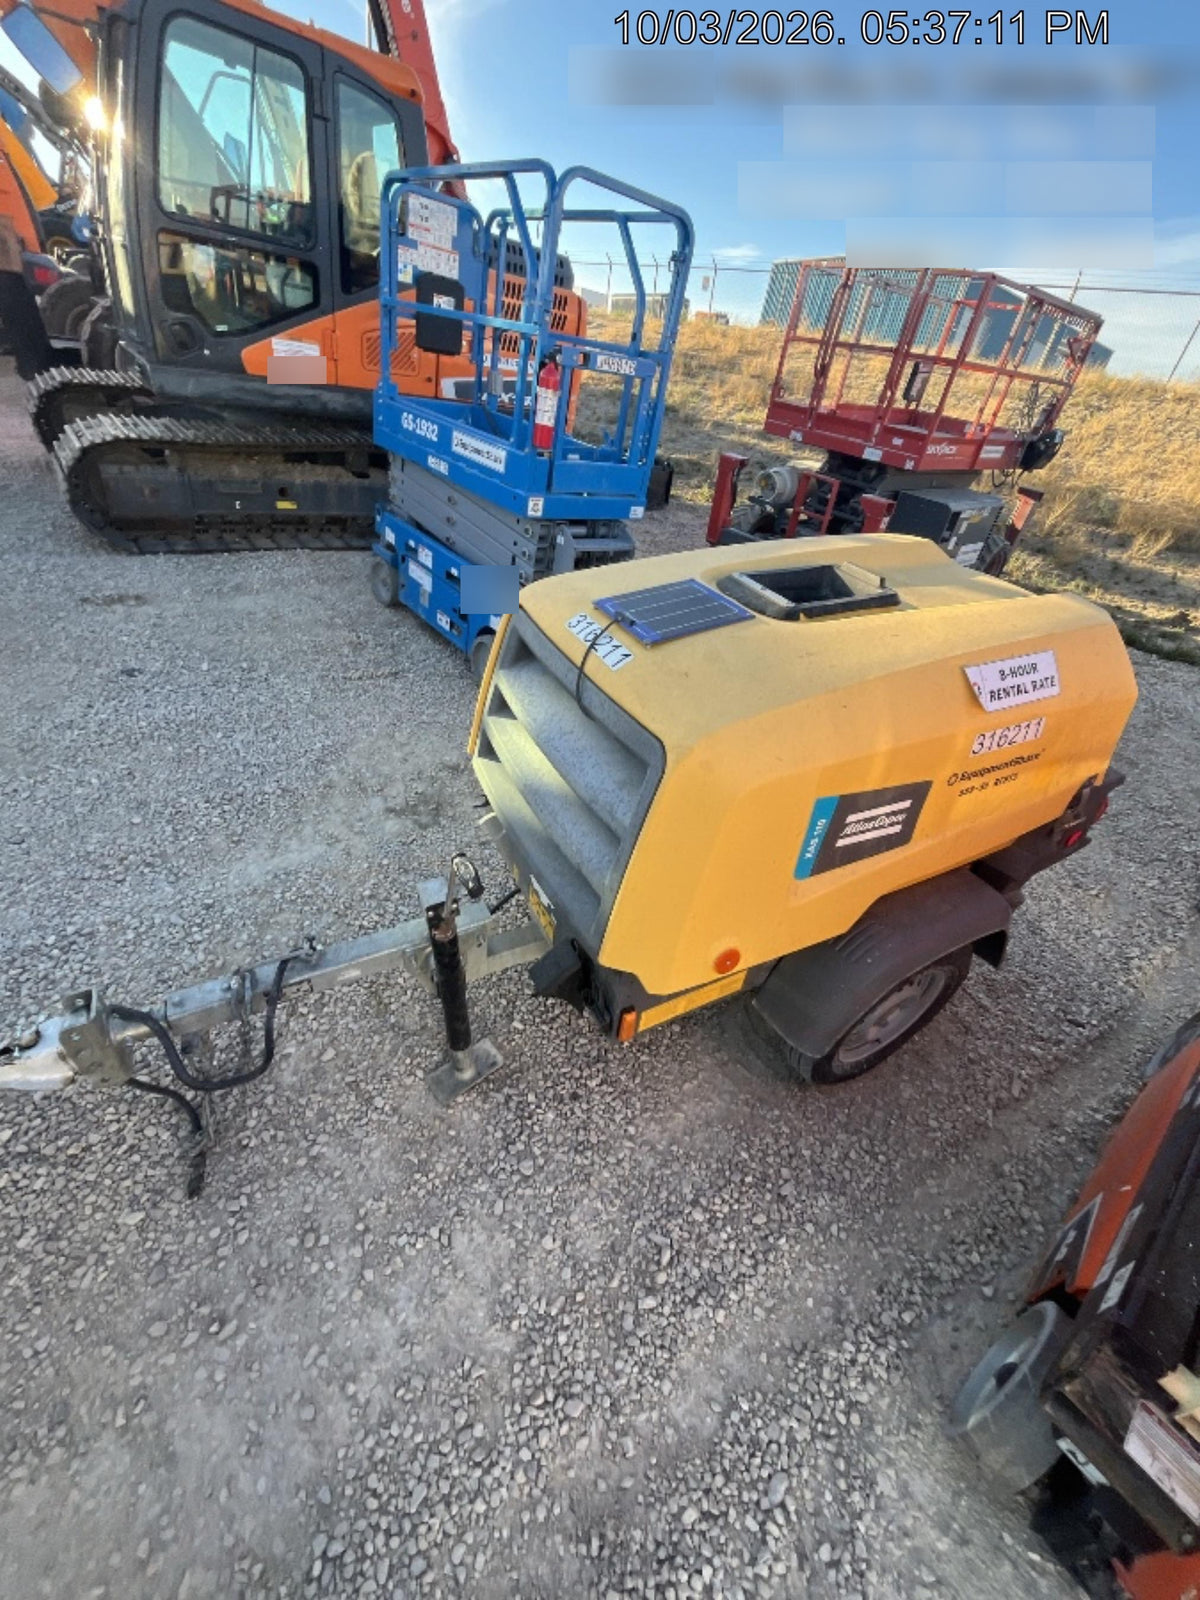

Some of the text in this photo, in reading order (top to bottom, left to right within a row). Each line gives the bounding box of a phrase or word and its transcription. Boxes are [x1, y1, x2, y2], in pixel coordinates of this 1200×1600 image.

[401, 412, 438, 442] GS-1932
[999, 662, 1039, 681] 8-HOUR
[989, 675, 1056, 702] RENTAL RATE
[972, 718, 1043, 755] 316211
